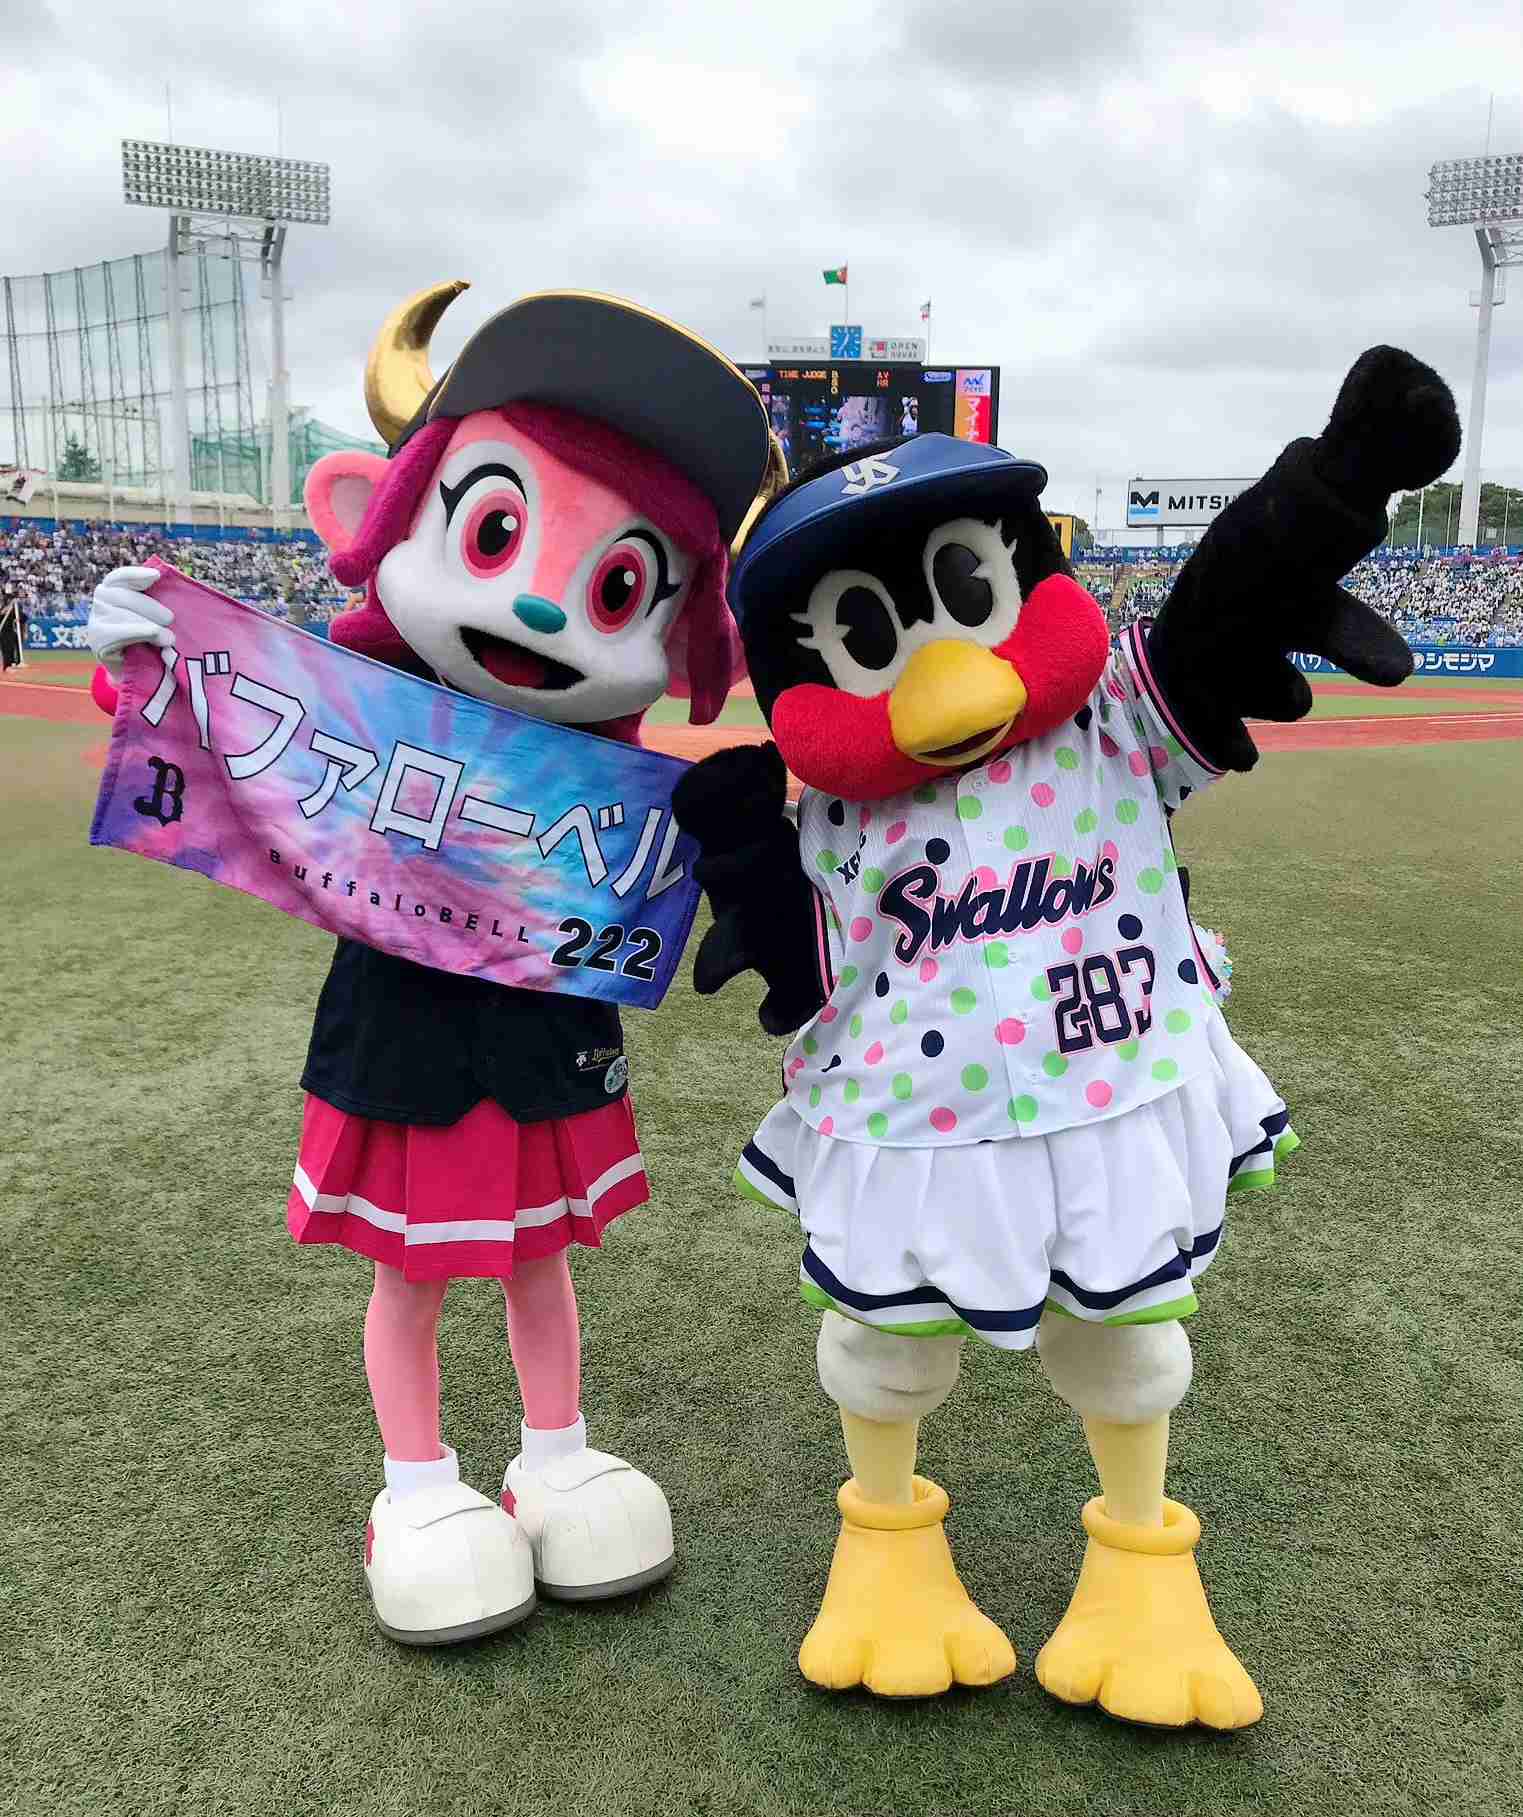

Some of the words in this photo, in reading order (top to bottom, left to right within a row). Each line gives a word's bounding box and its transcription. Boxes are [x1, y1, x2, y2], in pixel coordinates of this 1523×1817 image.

[1425, 652, 1495, 671] シモジマ
[140, 647, 687, 900] バファローベル
[550, 916, 664, 982] 222
[878, 854, 1118, 965] Swallows
